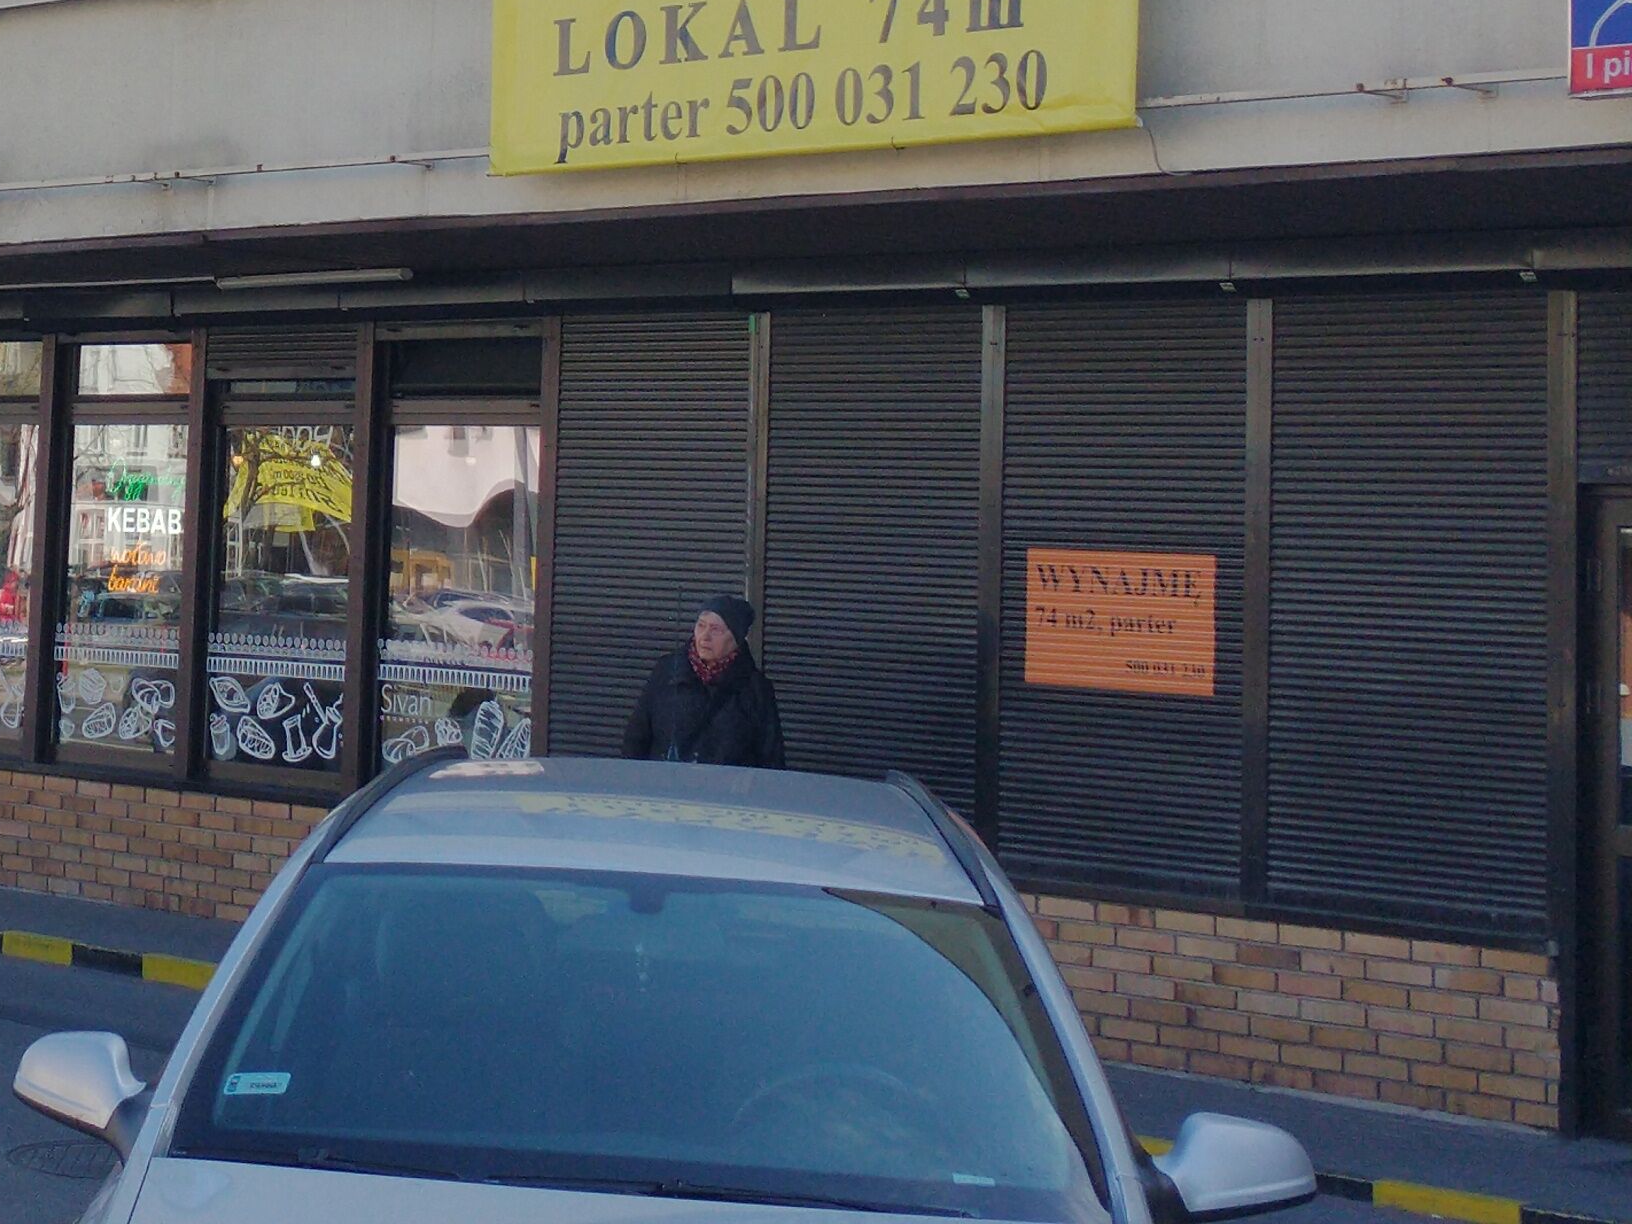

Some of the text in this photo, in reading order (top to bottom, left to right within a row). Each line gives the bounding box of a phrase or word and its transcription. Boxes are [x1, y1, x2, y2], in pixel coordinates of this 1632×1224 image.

[1604, 49, 1632, 84] pi
[555, 48, 1047, 164] parter 500 031 230
[107, 507, 182, 535] KEBAB
[1036, 564, 1202, 607] WYNAJMĘ
[1035, 607, 1058, 628] 74
[1110, 615, 1177, 637] parter
[381, 684, 431, 716] Sivan
